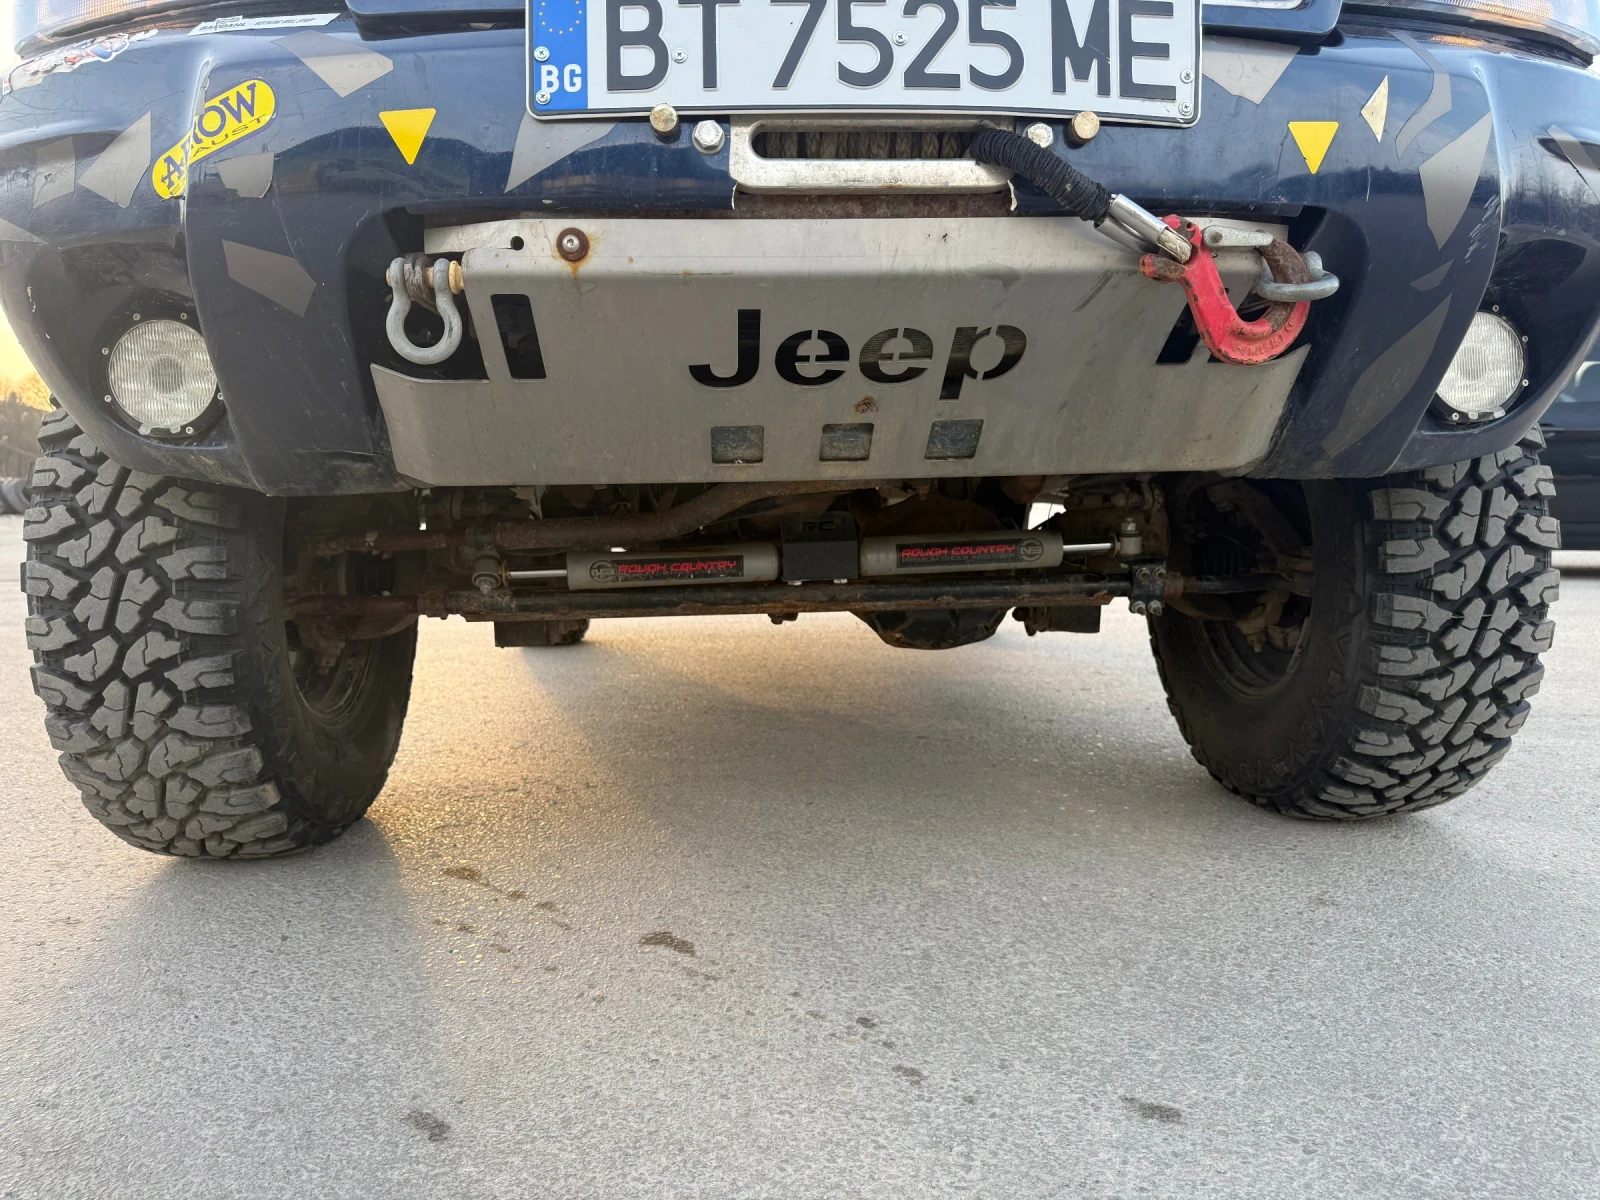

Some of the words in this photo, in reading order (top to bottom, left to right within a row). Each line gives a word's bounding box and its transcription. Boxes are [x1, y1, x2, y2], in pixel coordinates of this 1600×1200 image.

[606, 0, 741, 92] BT
[770, 0, 1025, 91] 7525
[1052, 0, 1177, 100] ME
[541, 63, 582, 93] BG
[688, 309, 1028, 401] Jeep
[901, 547, 948, 558] ROUGH
[951, 544, 1016, 555] COUNTRY
[618, 563, 667, 574] ROUGH
[670, 560, 737, 572] COUNTRY
